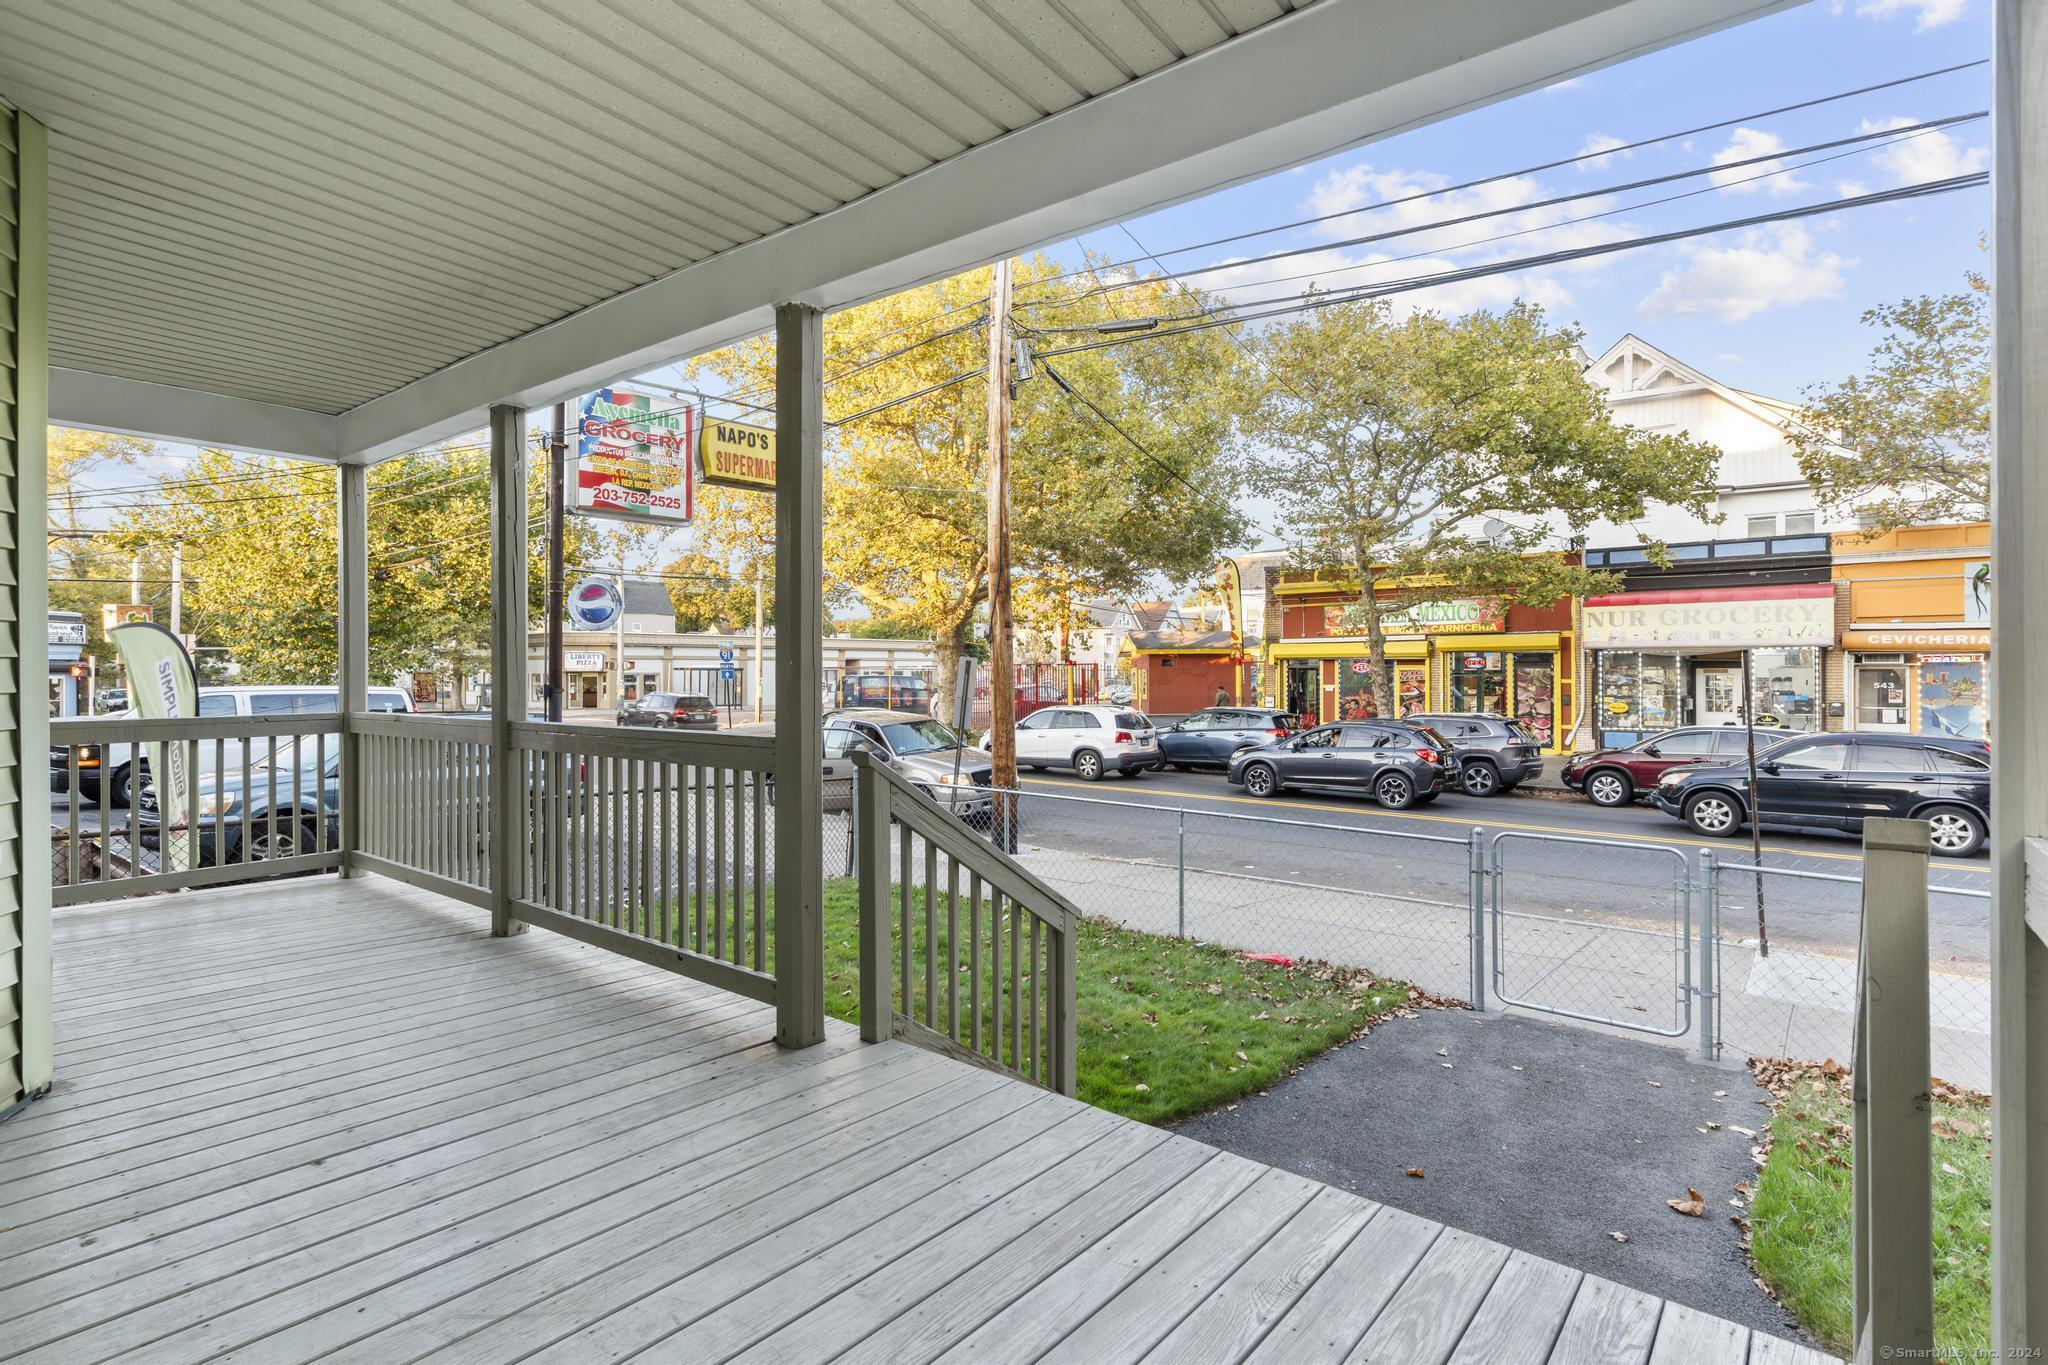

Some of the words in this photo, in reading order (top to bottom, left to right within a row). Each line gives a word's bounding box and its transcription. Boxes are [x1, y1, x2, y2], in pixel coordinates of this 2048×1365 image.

[584, 420, 685, 452] GROCERY
[717, 425, 769, 450] NAPO'S
[588, 444, 624, 456] PRODUCTOS
[593, 487, 681, 510] 203-752-2525
[1419, 603, 1479, 622] MEXICO
[1586, 609, 1648, 628] NUR
[1867, 634, 1991, 645] CEVICHERIA
[721, 652, 730, 660] 91
[159, 661, 180, 717] SIMPL
